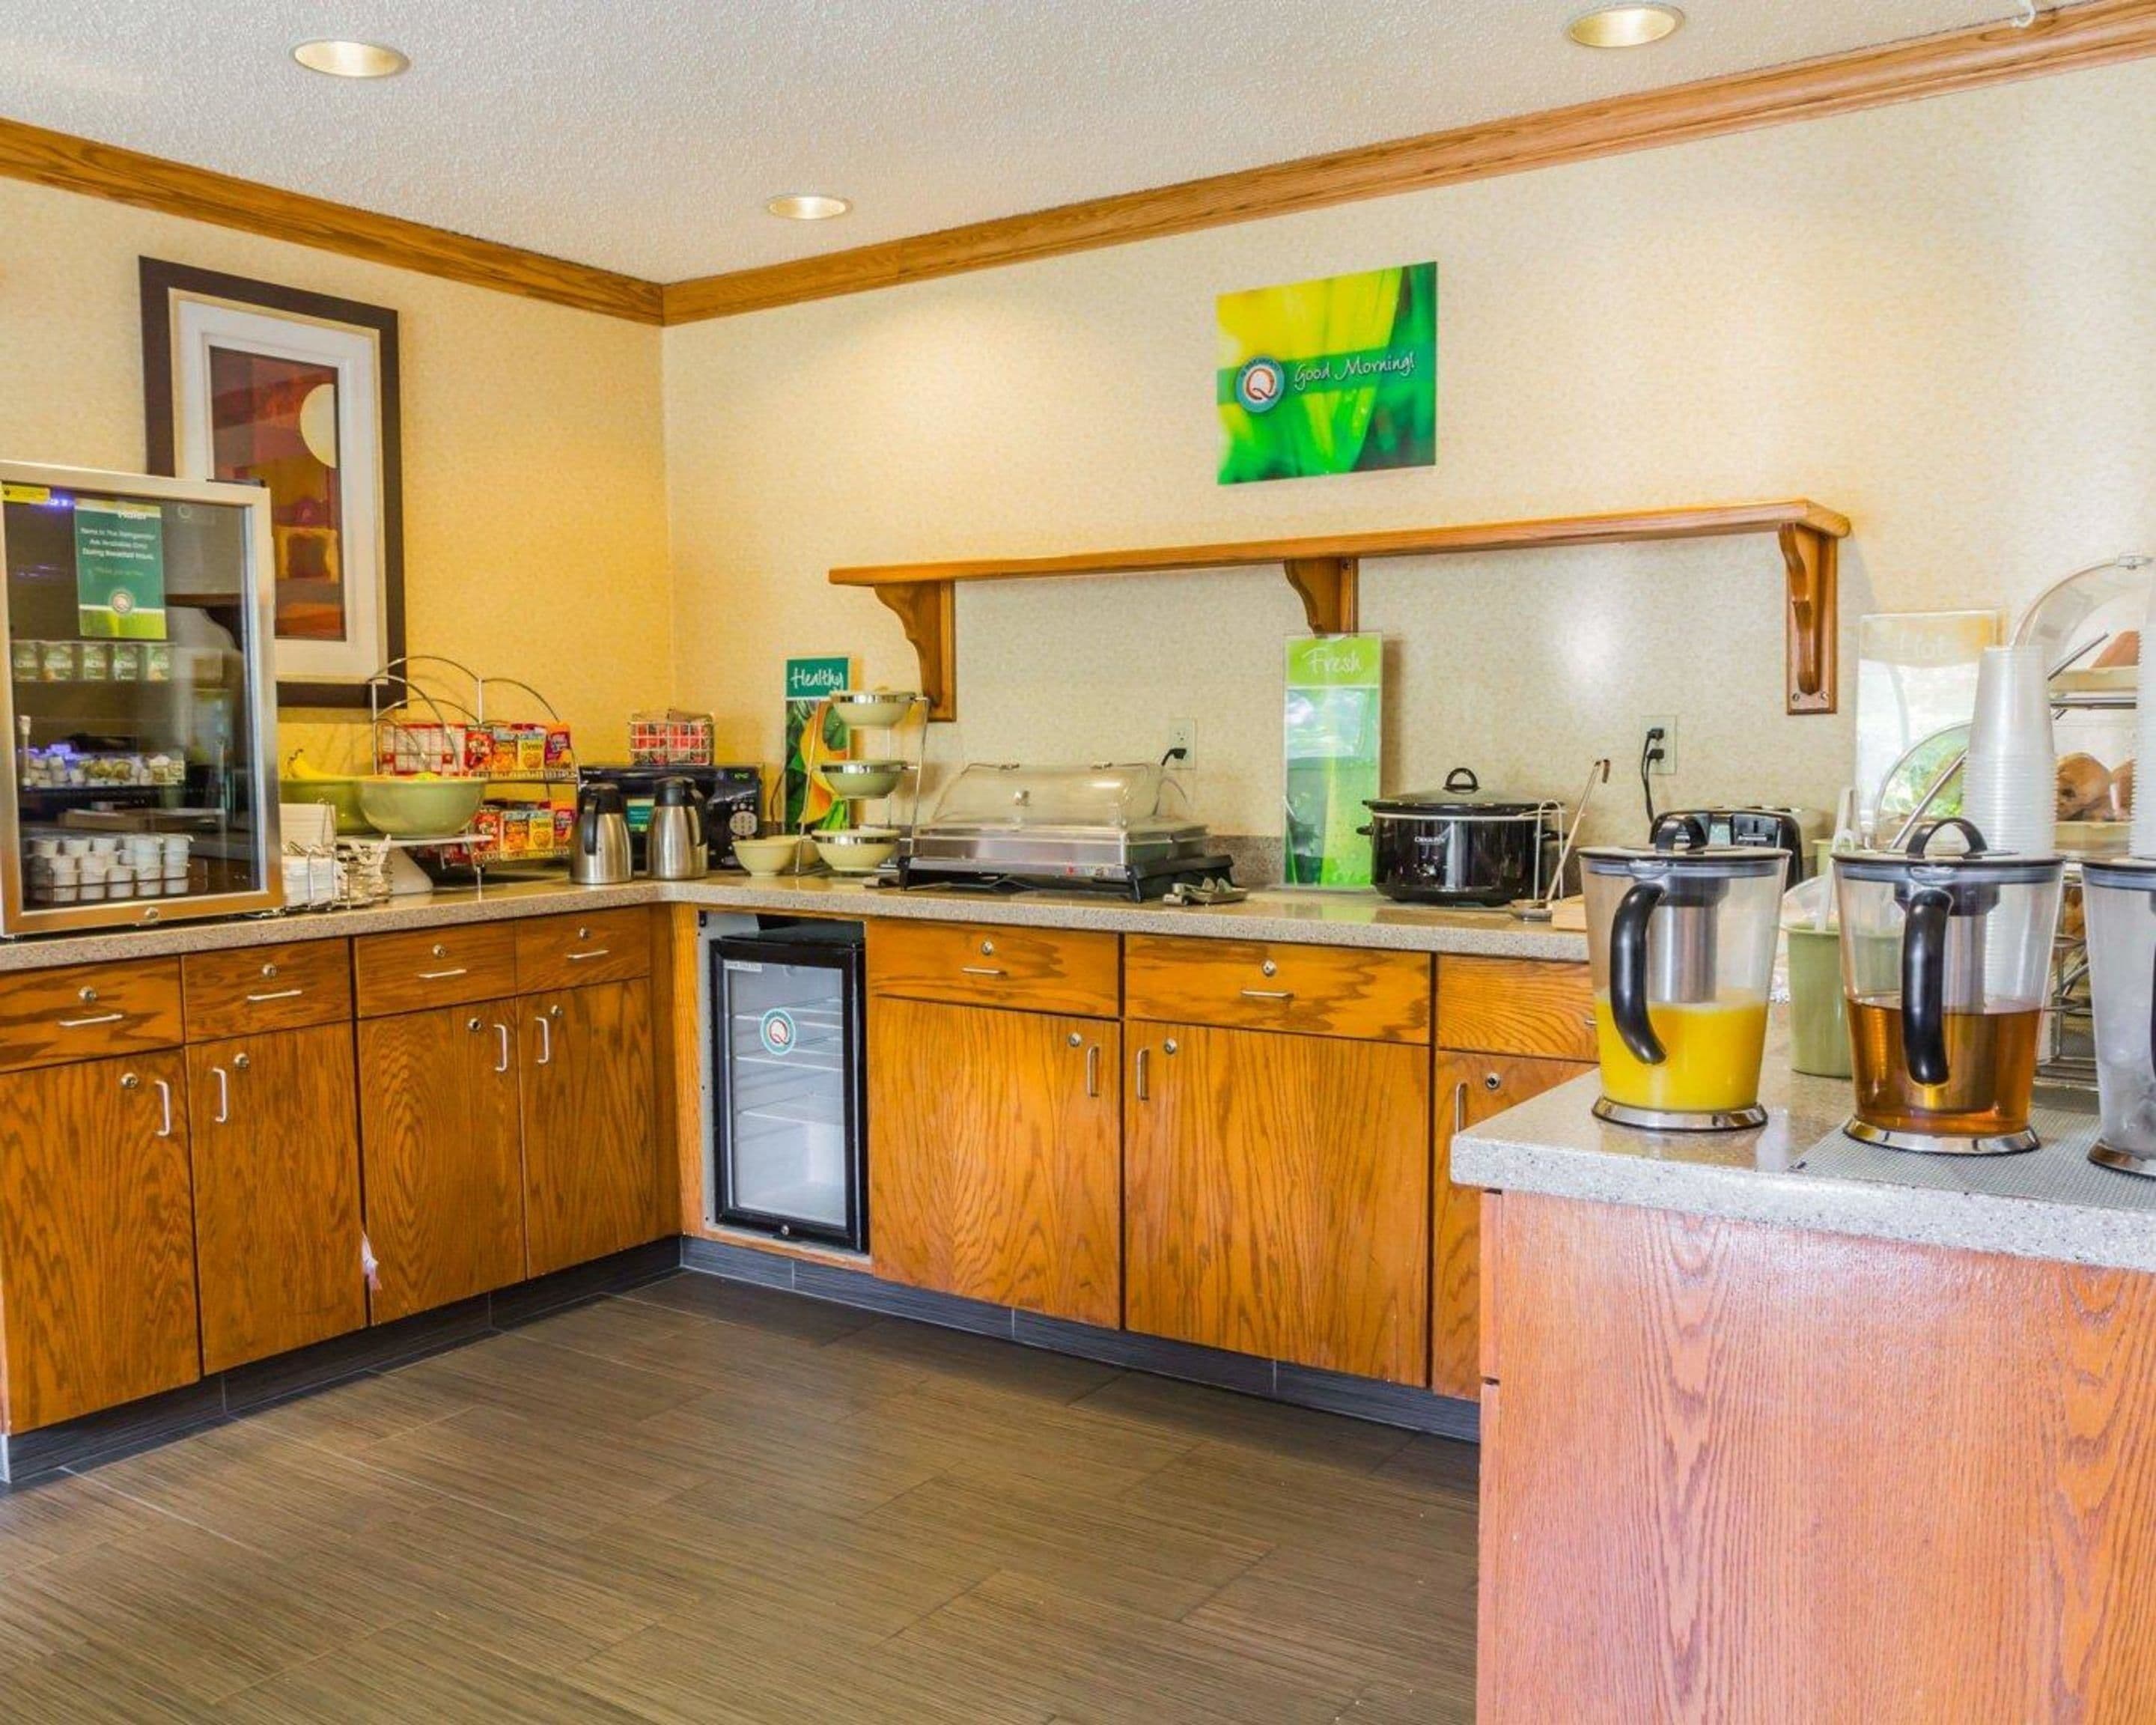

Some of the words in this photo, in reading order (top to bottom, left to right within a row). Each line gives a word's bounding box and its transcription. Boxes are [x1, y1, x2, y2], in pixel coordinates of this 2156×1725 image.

[1294, 362, 1330, 390] Good
[1335, 351, 1415, 380] Morning!
[1302, 647, 1361, 673] Fresh
[791, 666, 844, 691] Healthy
